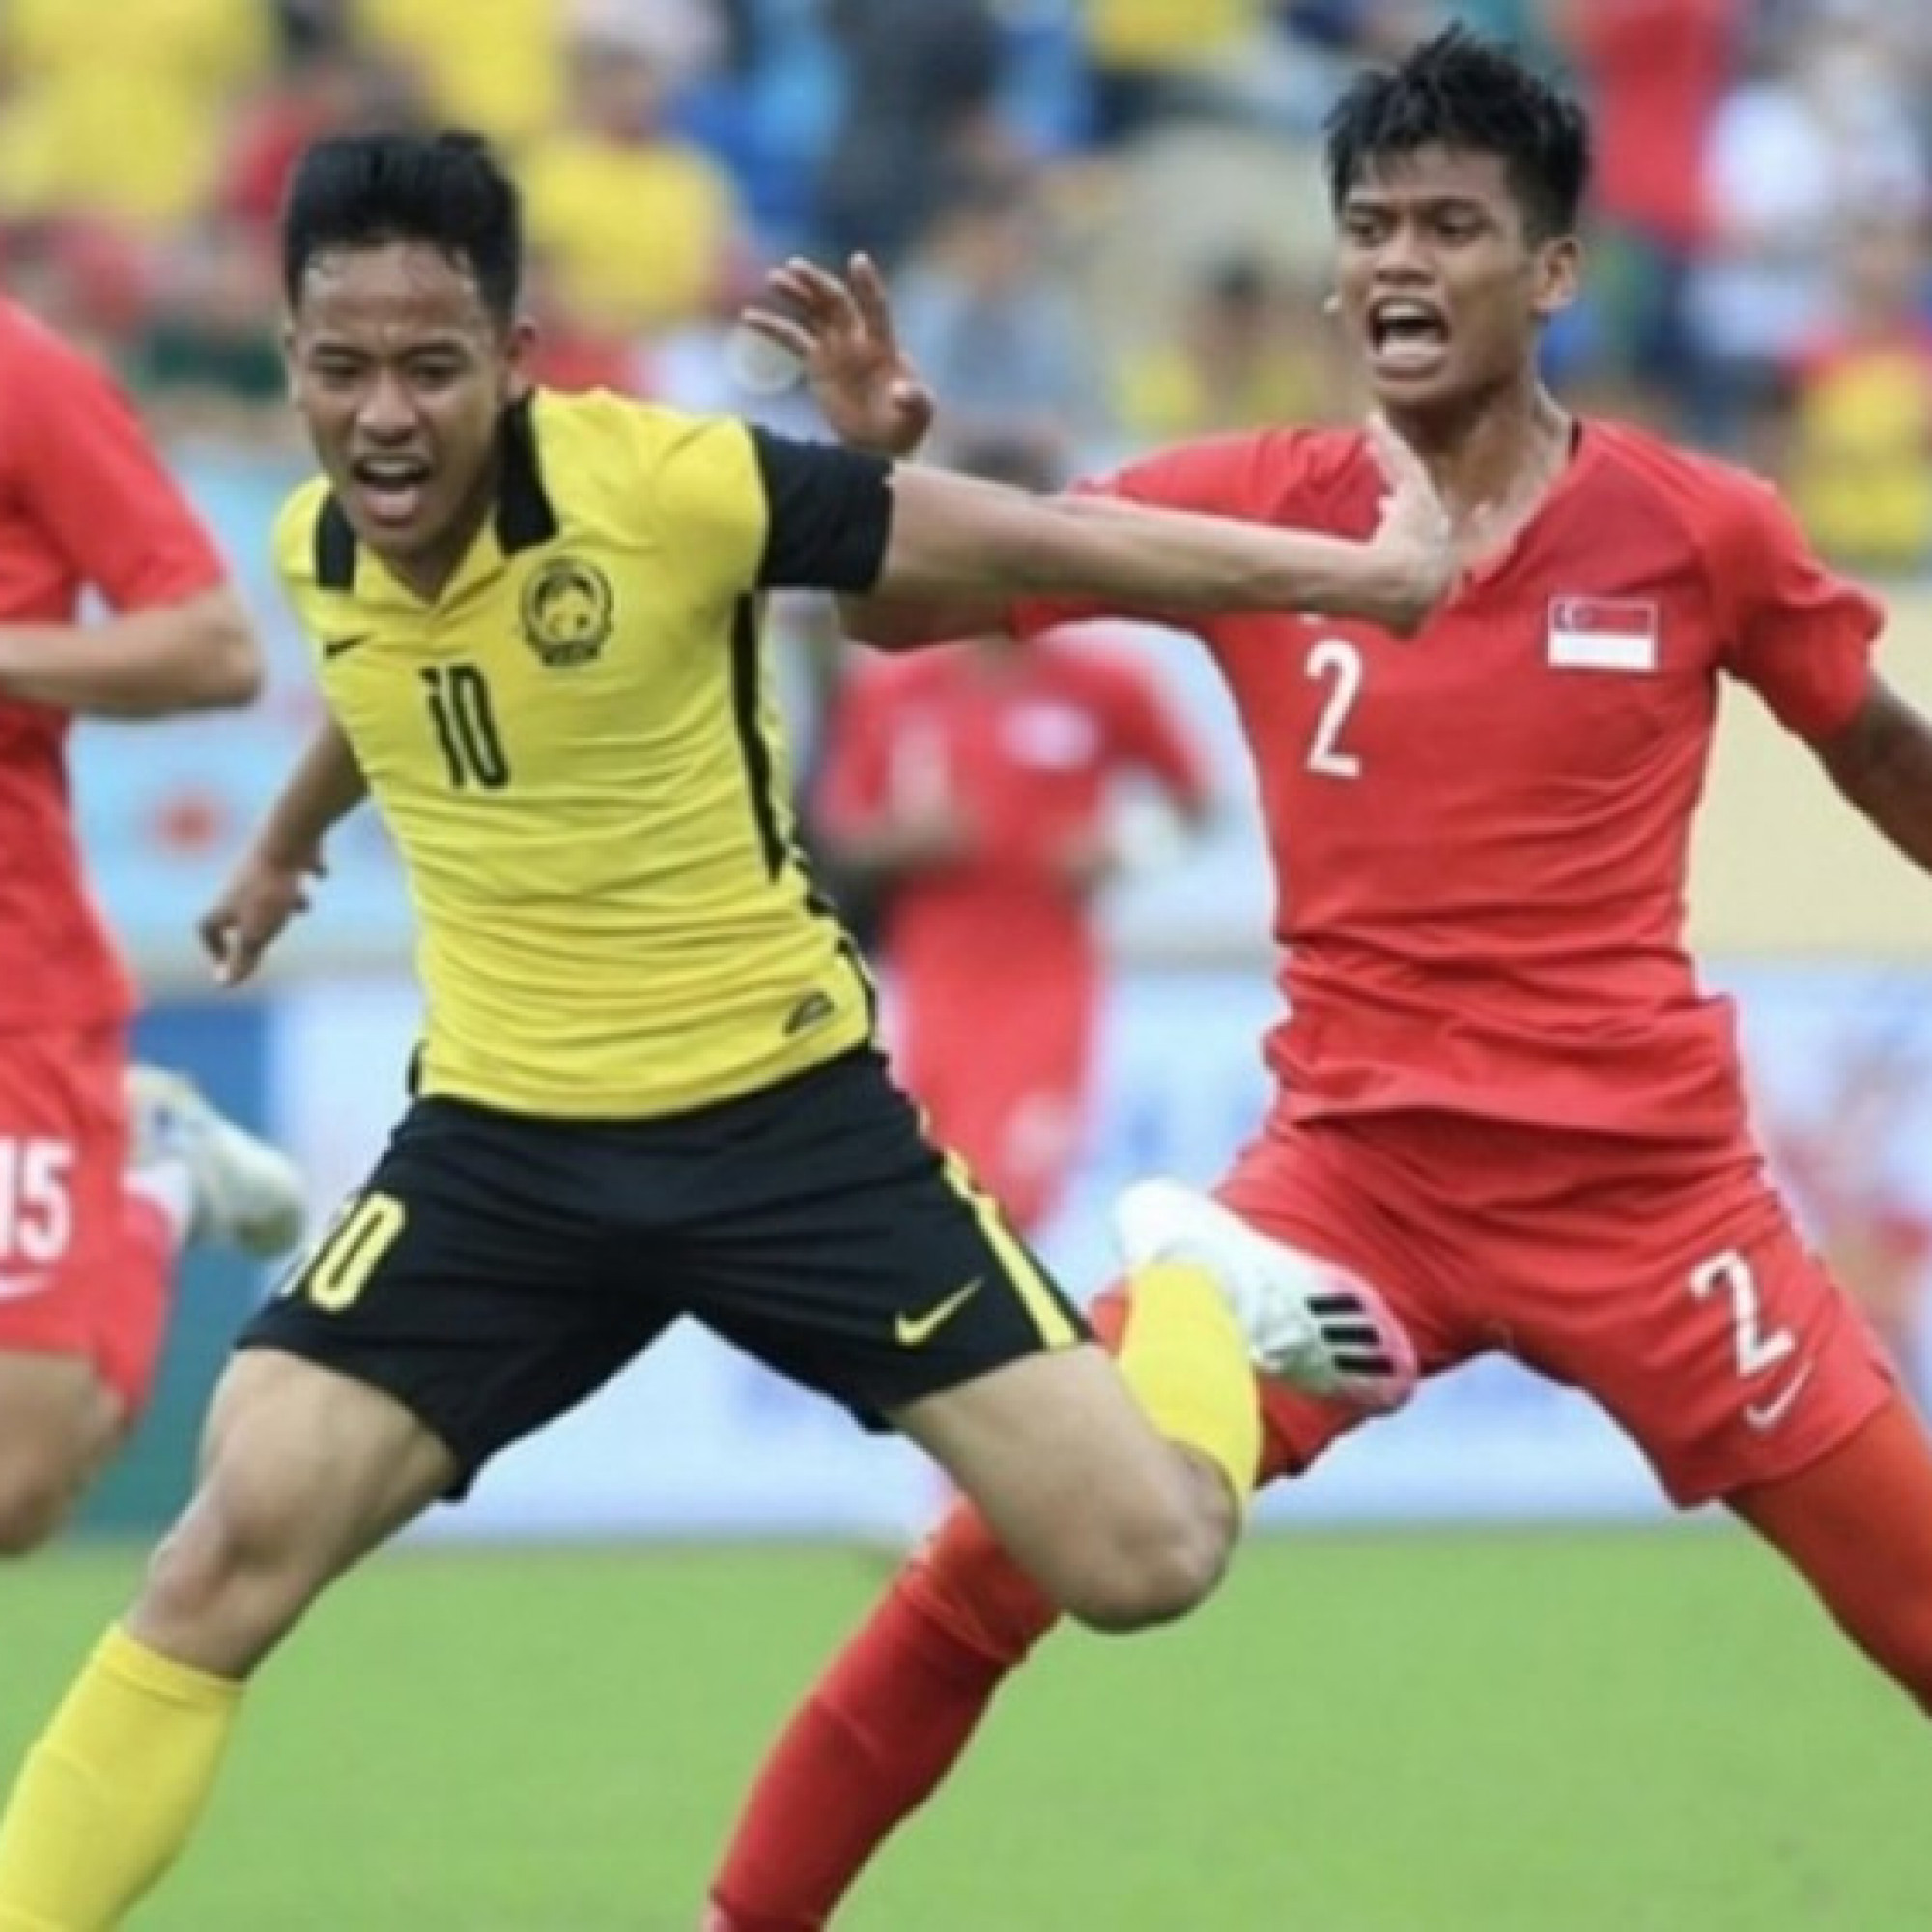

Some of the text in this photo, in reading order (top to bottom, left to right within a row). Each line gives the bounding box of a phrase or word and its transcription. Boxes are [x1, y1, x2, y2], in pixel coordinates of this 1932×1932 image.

[419, 663, 511, 790] 10
[1304, 638, 1363, 778] 2
[1689, 1250, 1796, 1378] 2
